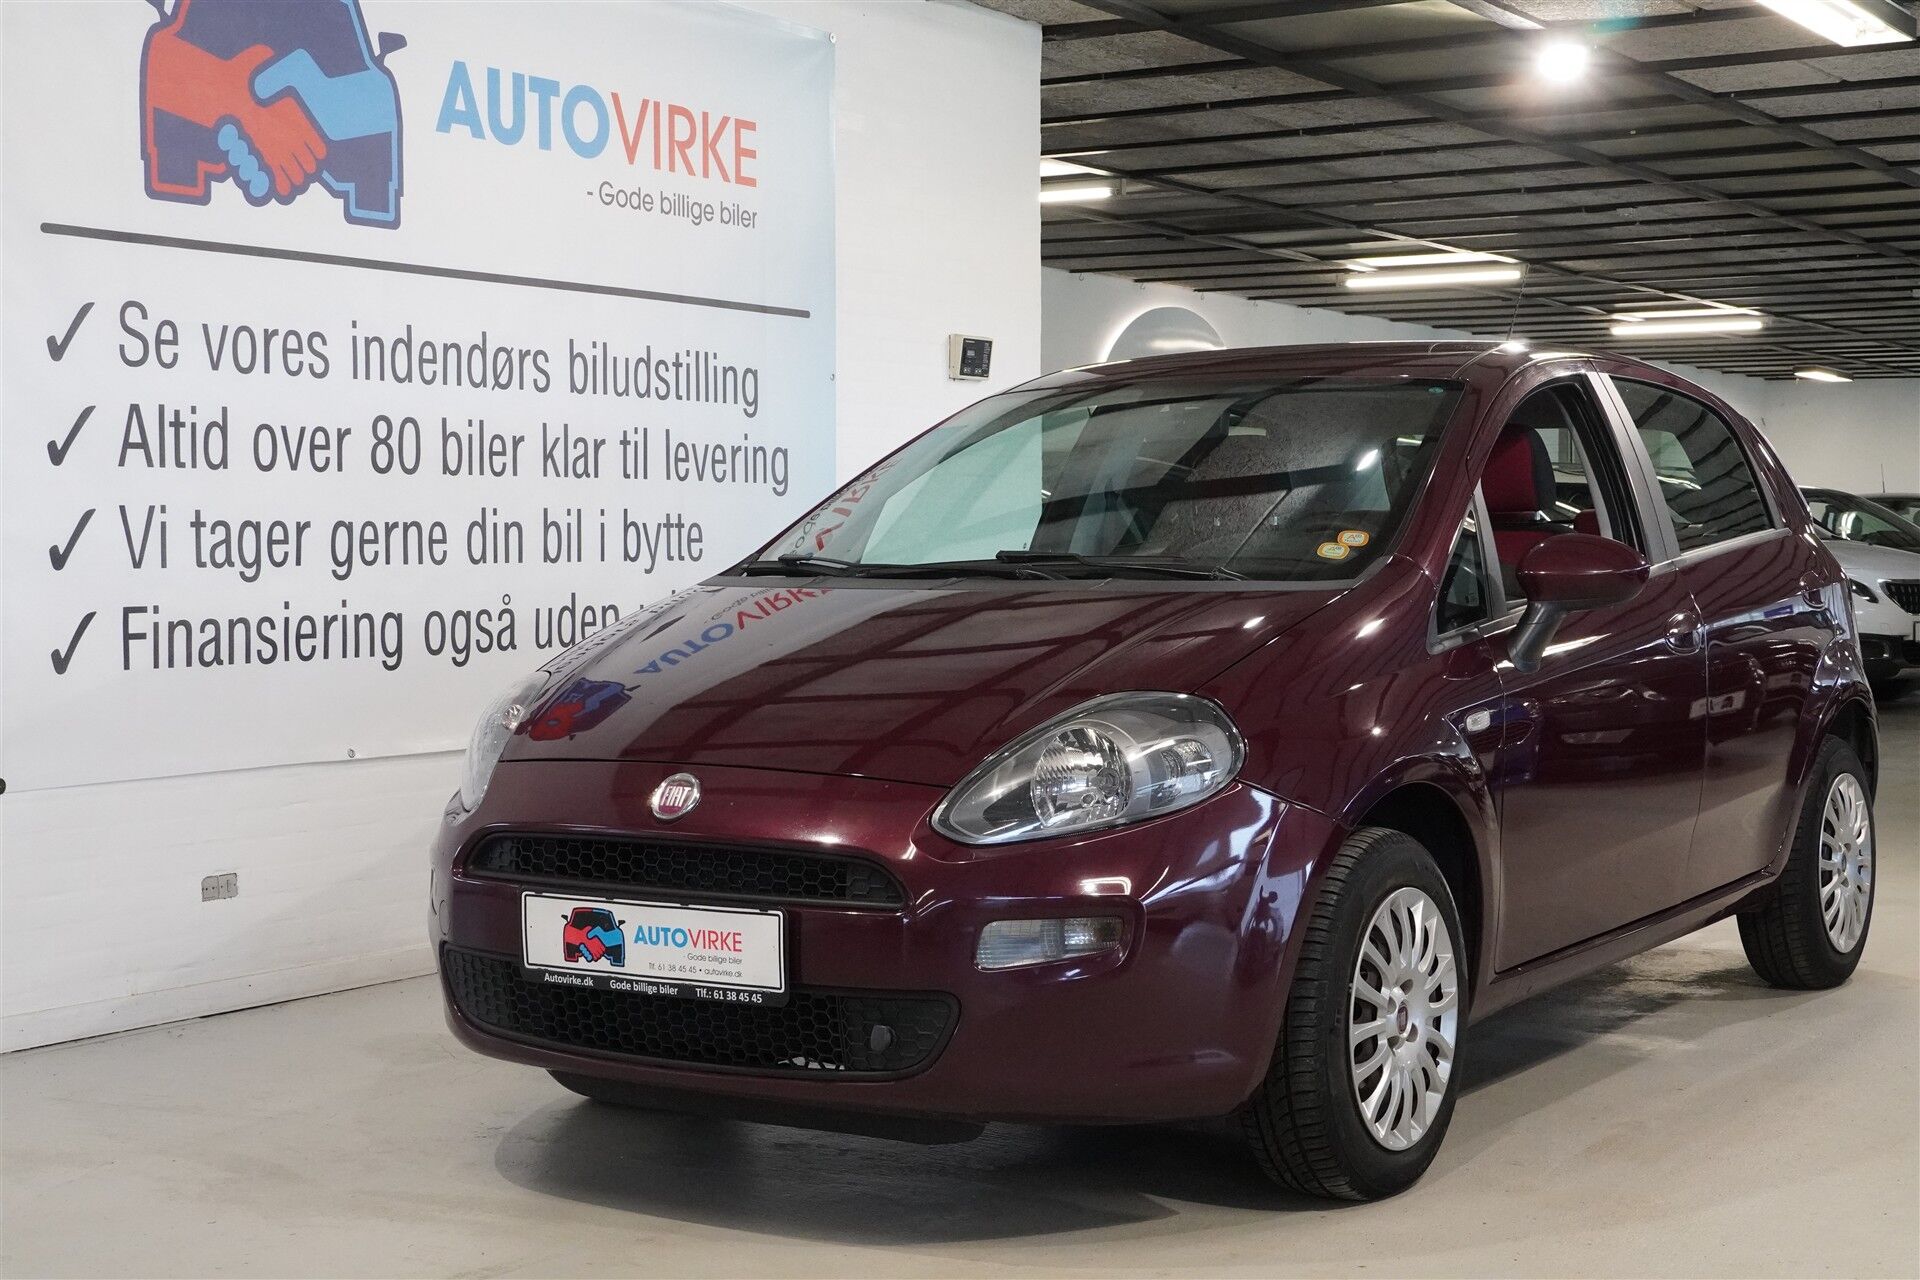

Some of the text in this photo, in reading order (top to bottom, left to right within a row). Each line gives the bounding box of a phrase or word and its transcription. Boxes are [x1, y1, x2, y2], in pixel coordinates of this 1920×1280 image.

[436, 61, 758, 188] AUTOVIRKE
[599, 180, 654, 212] Gode
[660, 190, 714, 226] billige
[720, 201, 757, 229] biler
[118, 301, 759, 419] Se vores indendørs biludstilling
[118, 403, 789, 497] Altid over 80 biler klar til levering
[119, 505, 704, 587] Vi tager gerne din bil i bytte
[122, 600, 403, 672] Finansiering
[425, 593, 518, 672] også
[660, 785, 692, 808] FIAT
[633, 924, 743, 953] AUTOVIRKE
[687, 952, 742, 965] Gode billige biler
[544, 972, 763, 1004] Autovirke.dk Gode billige biler Tlf.: 61 38 45 45
[657, 963, 666, 971] 61
[668, 964, 677, 972] 38
[678, 965, 687, 973] 45
[688, 966, 697, 974] 45
[704, 967, 743, 978] autovirke.dk
